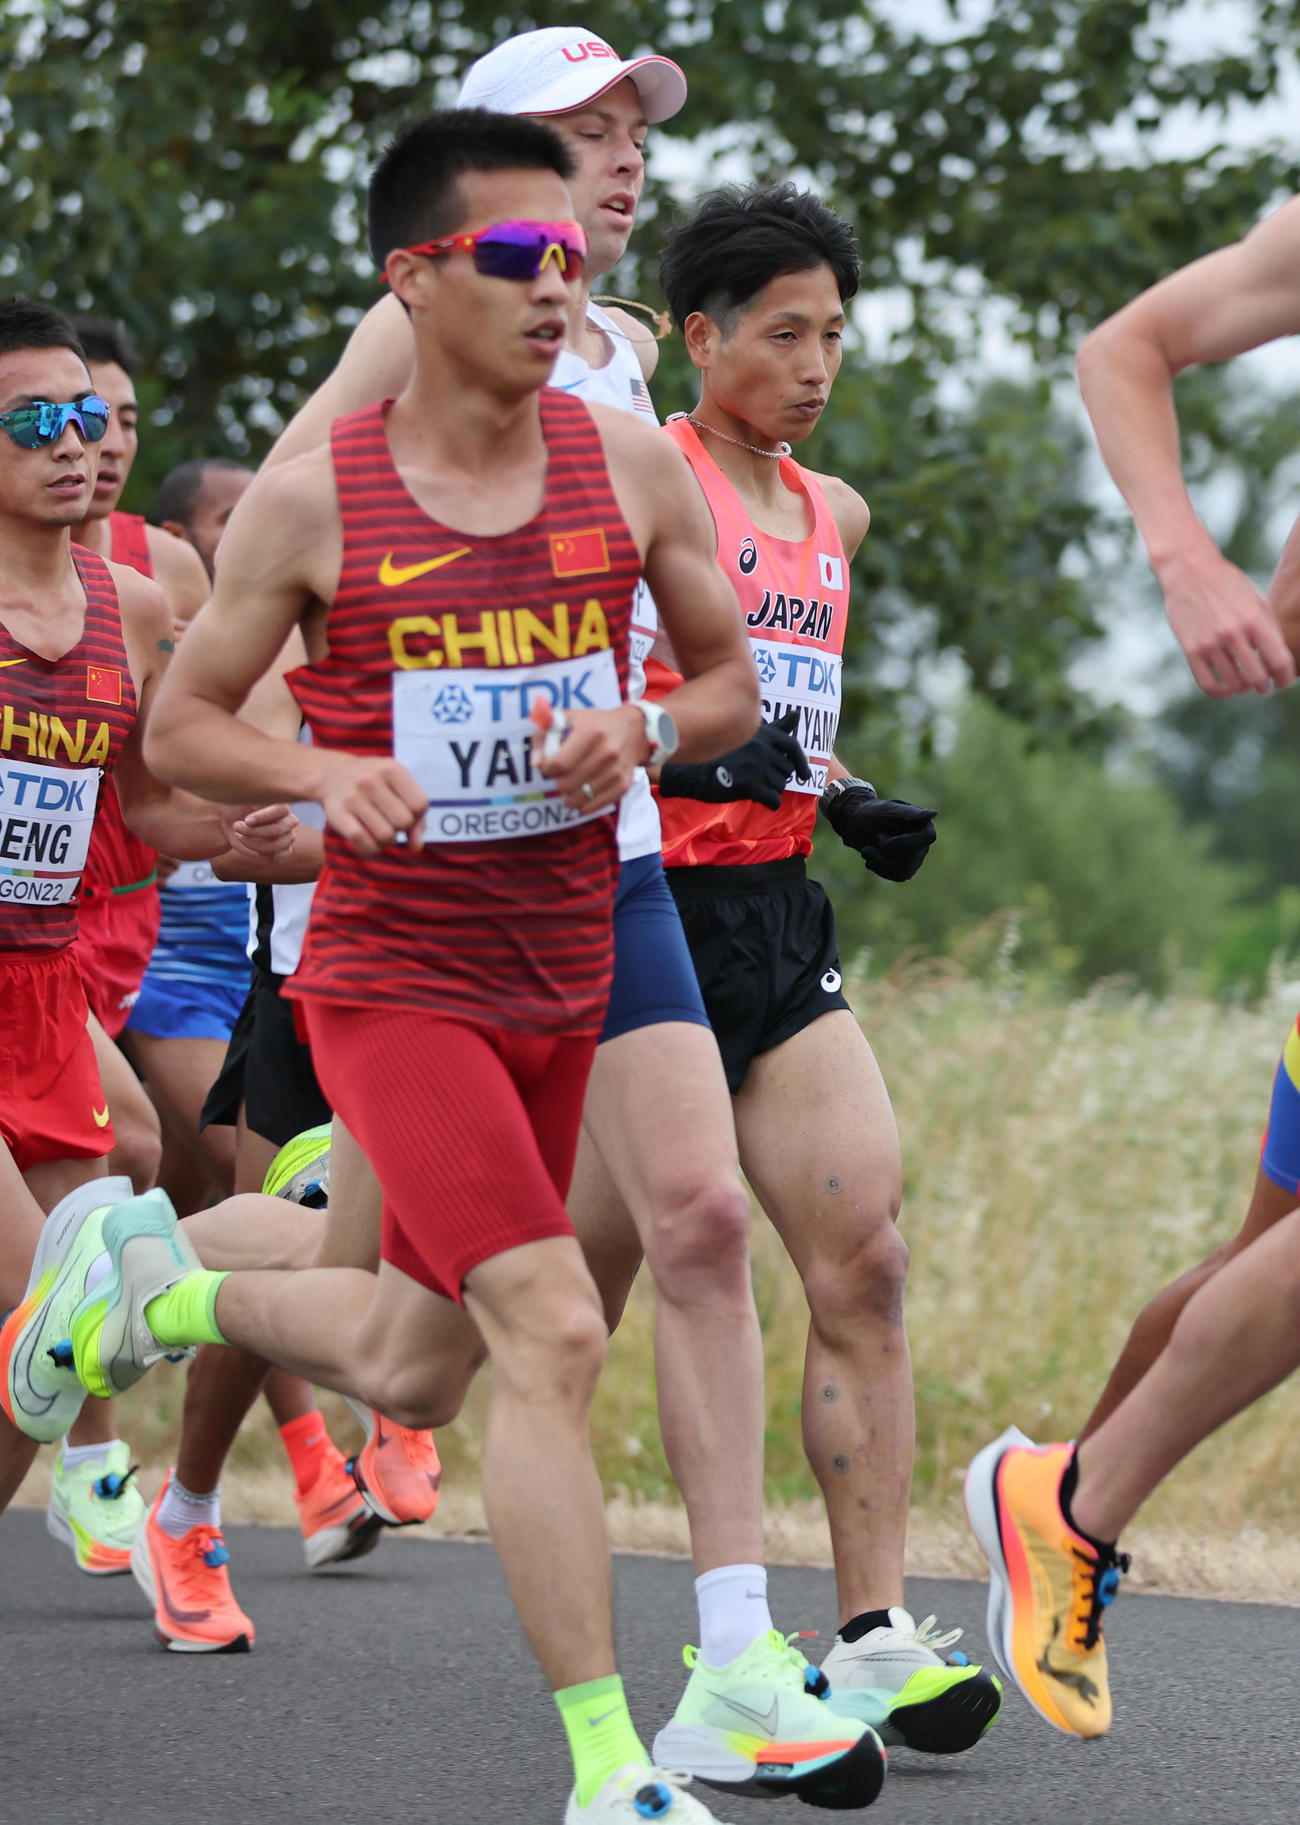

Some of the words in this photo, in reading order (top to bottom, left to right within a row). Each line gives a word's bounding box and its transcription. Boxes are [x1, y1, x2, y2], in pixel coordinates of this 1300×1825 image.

[387, 599, 611, 670] CHINA
[746, 590, 834, 642] JAPAN
[473, 670, 595, 722] TDK
[777, 651, 836, 697] TDK
[0, 704, 110, 765] HINA
[7, 770, 88, 812] TDK
[0, 818, 72, 865] ENG
